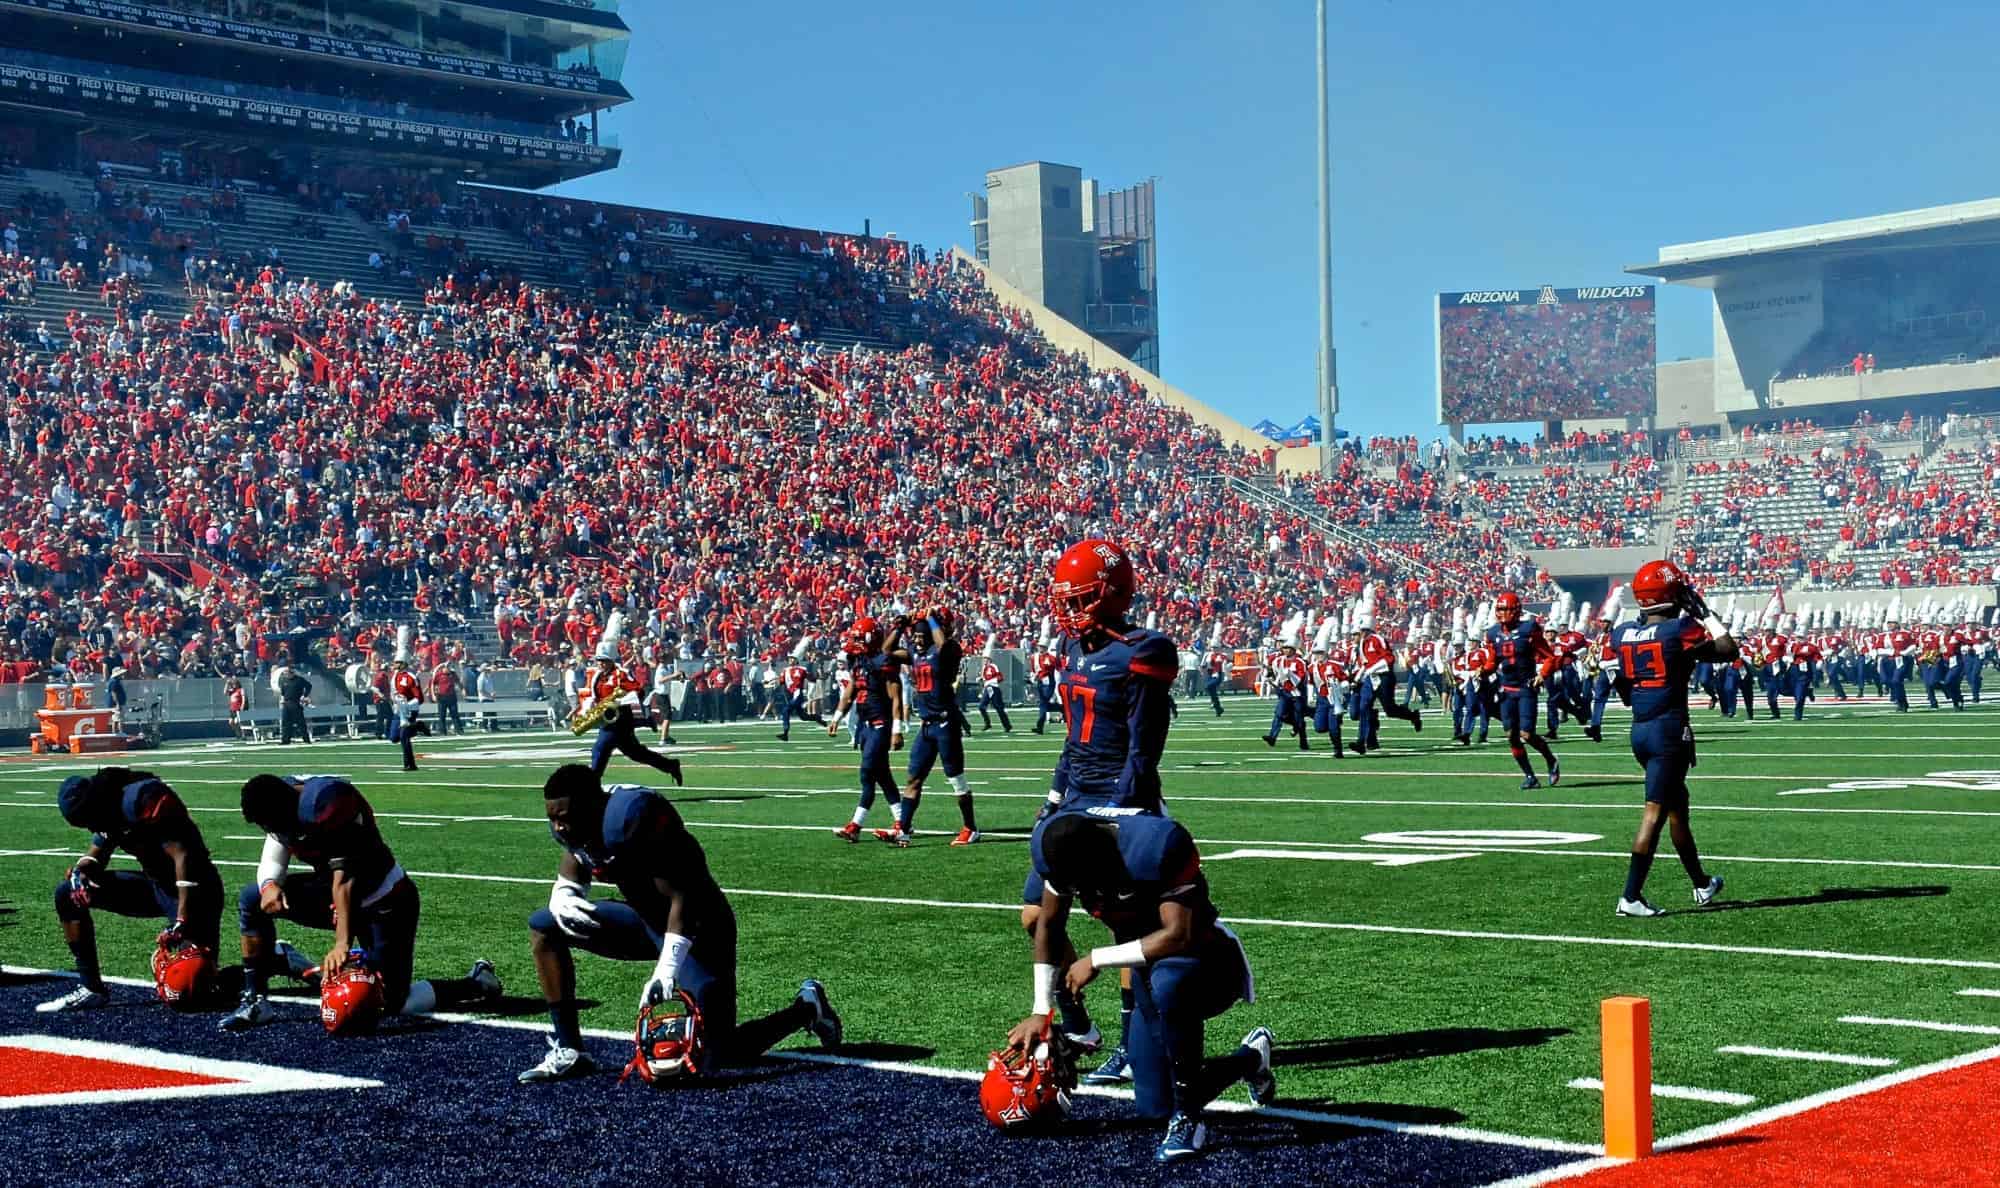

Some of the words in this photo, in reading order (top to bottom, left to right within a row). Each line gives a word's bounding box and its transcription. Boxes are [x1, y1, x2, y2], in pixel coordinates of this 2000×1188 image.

[48, 73, 70, 85] BELL
[77, 77, 101, 89] FRED
[148, 87, 183, 101] STEVEN
[244, 101, 268, 113] JOSH
[271, 106, 302, 118] MILLER
[307, 110, 337, 122] CHUCK
[367, 118, 392, 130] MARK
[438, 126, 462, 139] RICKY
[1459, 291, 1520, 304] ARIZONA
[1577, 286, 1645, 299] WILDCATS
[1620, 641, 1667, 688] 13
[1059, 683, 1097, 744] 17
[74, 718, 95, 734] G
